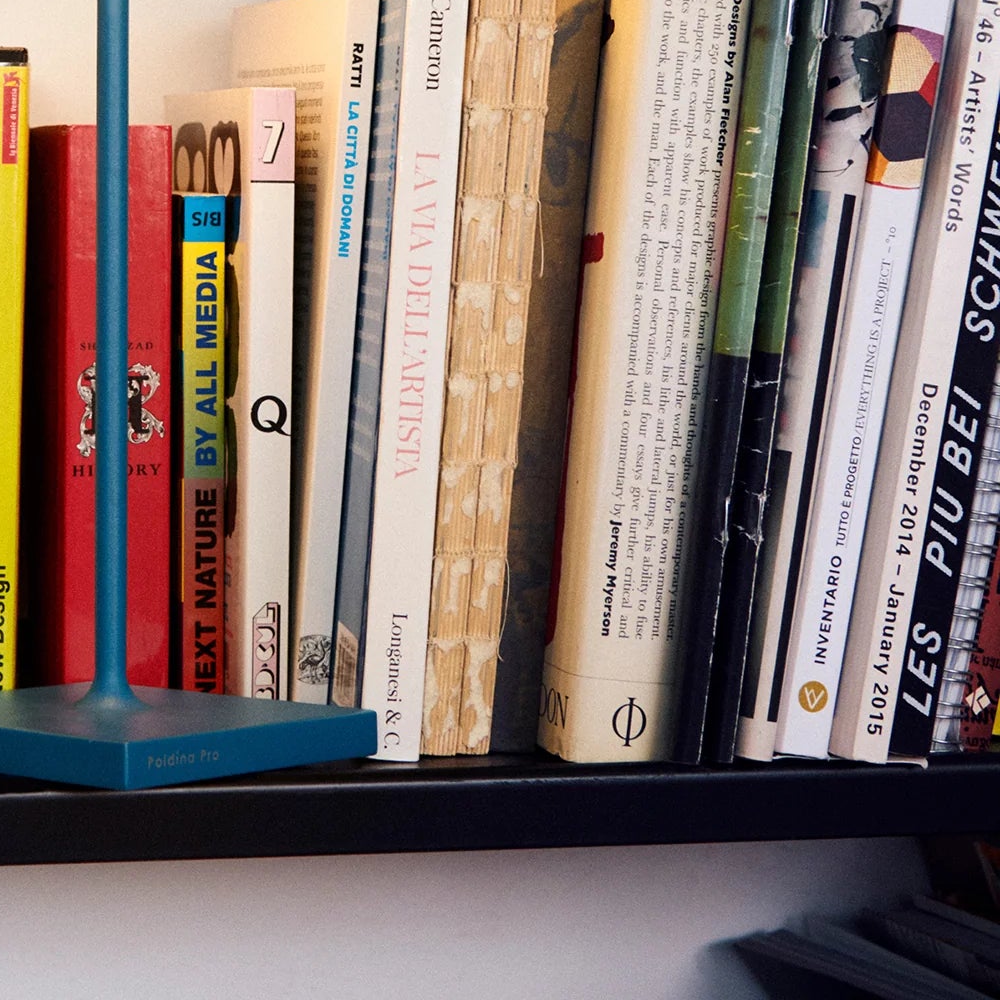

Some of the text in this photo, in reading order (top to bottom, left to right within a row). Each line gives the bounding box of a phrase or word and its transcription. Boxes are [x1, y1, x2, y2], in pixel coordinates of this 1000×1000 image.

[724, 48, 738, 69] by
[976, 18, 994, 44] 46
[723, 71, 735, 106] Alan
[262, 119, 285, 164] 7
[338, 42, 364, 259] RATTI LA CITTÀ DI DOMANI
[717, 108, 733, 167] Fletcher
[413, 152, 441, 191] LA
[945, 162, 973, 233] Words
[408, 200, 437, 253] VIA
[250, 395, 292, 437] Q
[905, 382, 939, 497] December
[194, 250, 218, 694] NEXT NATURE BY ALL MEDIA
[814, 555, 843, 665] INVENTARIO
[835, 510, 850, 547] TUTTO
[873, 257, 892, 316] PROJECT
[896, 503, 919, 556] 2014
[902, 385, 983, 717] LES PIU BEI
[600, 519, 623, 638] Jeremy Myerson
[873, 583, 906, 676] January
[383, 613, 408, 750] Longanesi & C.
[866, 682, 890, 736] 2015
[147, 749, 220, 769] Poldina Pro
